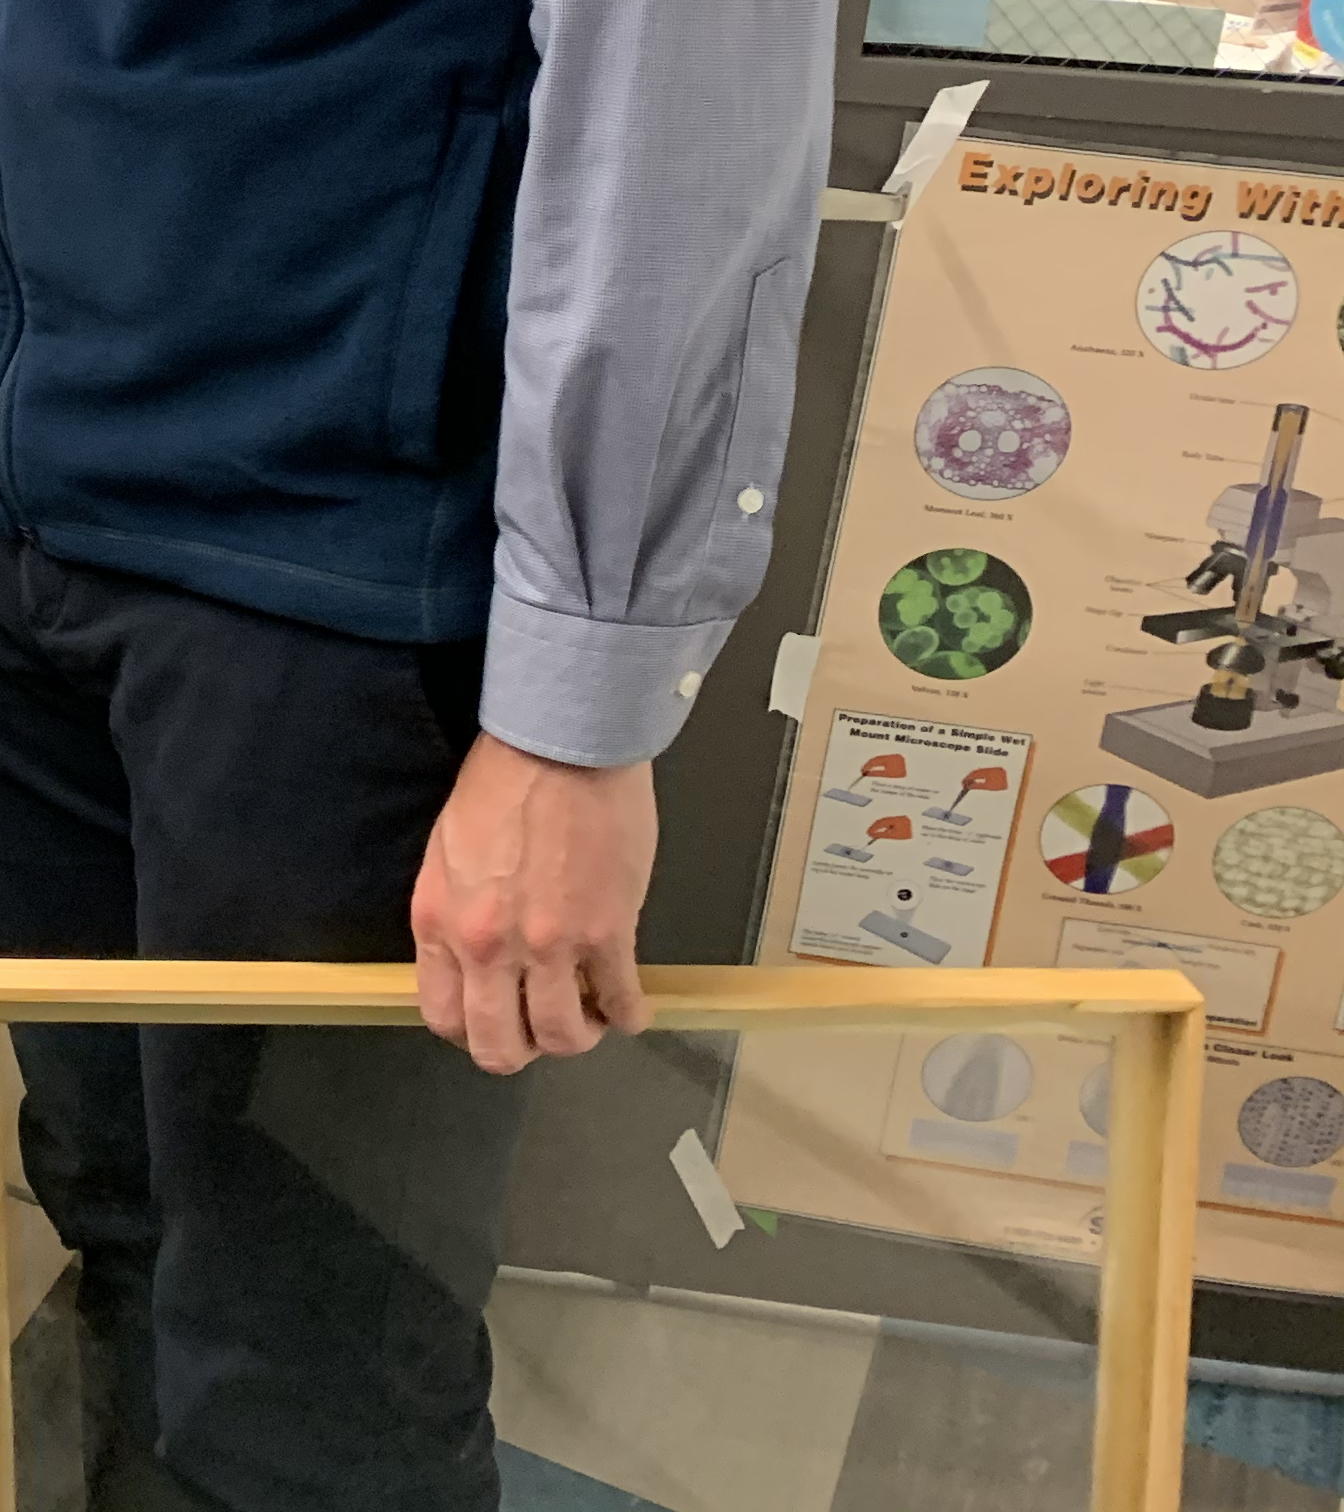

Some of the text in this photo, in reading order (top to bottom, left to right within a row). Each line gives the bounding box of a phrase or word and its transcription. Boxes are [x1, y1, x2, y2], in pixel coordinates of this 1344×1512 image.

[957, 151, 1213, 222] Exploring
[838, 713, 916, 732] Preparation
[920, 724, 933, 734] of
[950, 728, 996, 742] Simple
[1000, 734, 1026, 747] Wet
[849, 728, 1010, 758] Mount Microscope Slide
